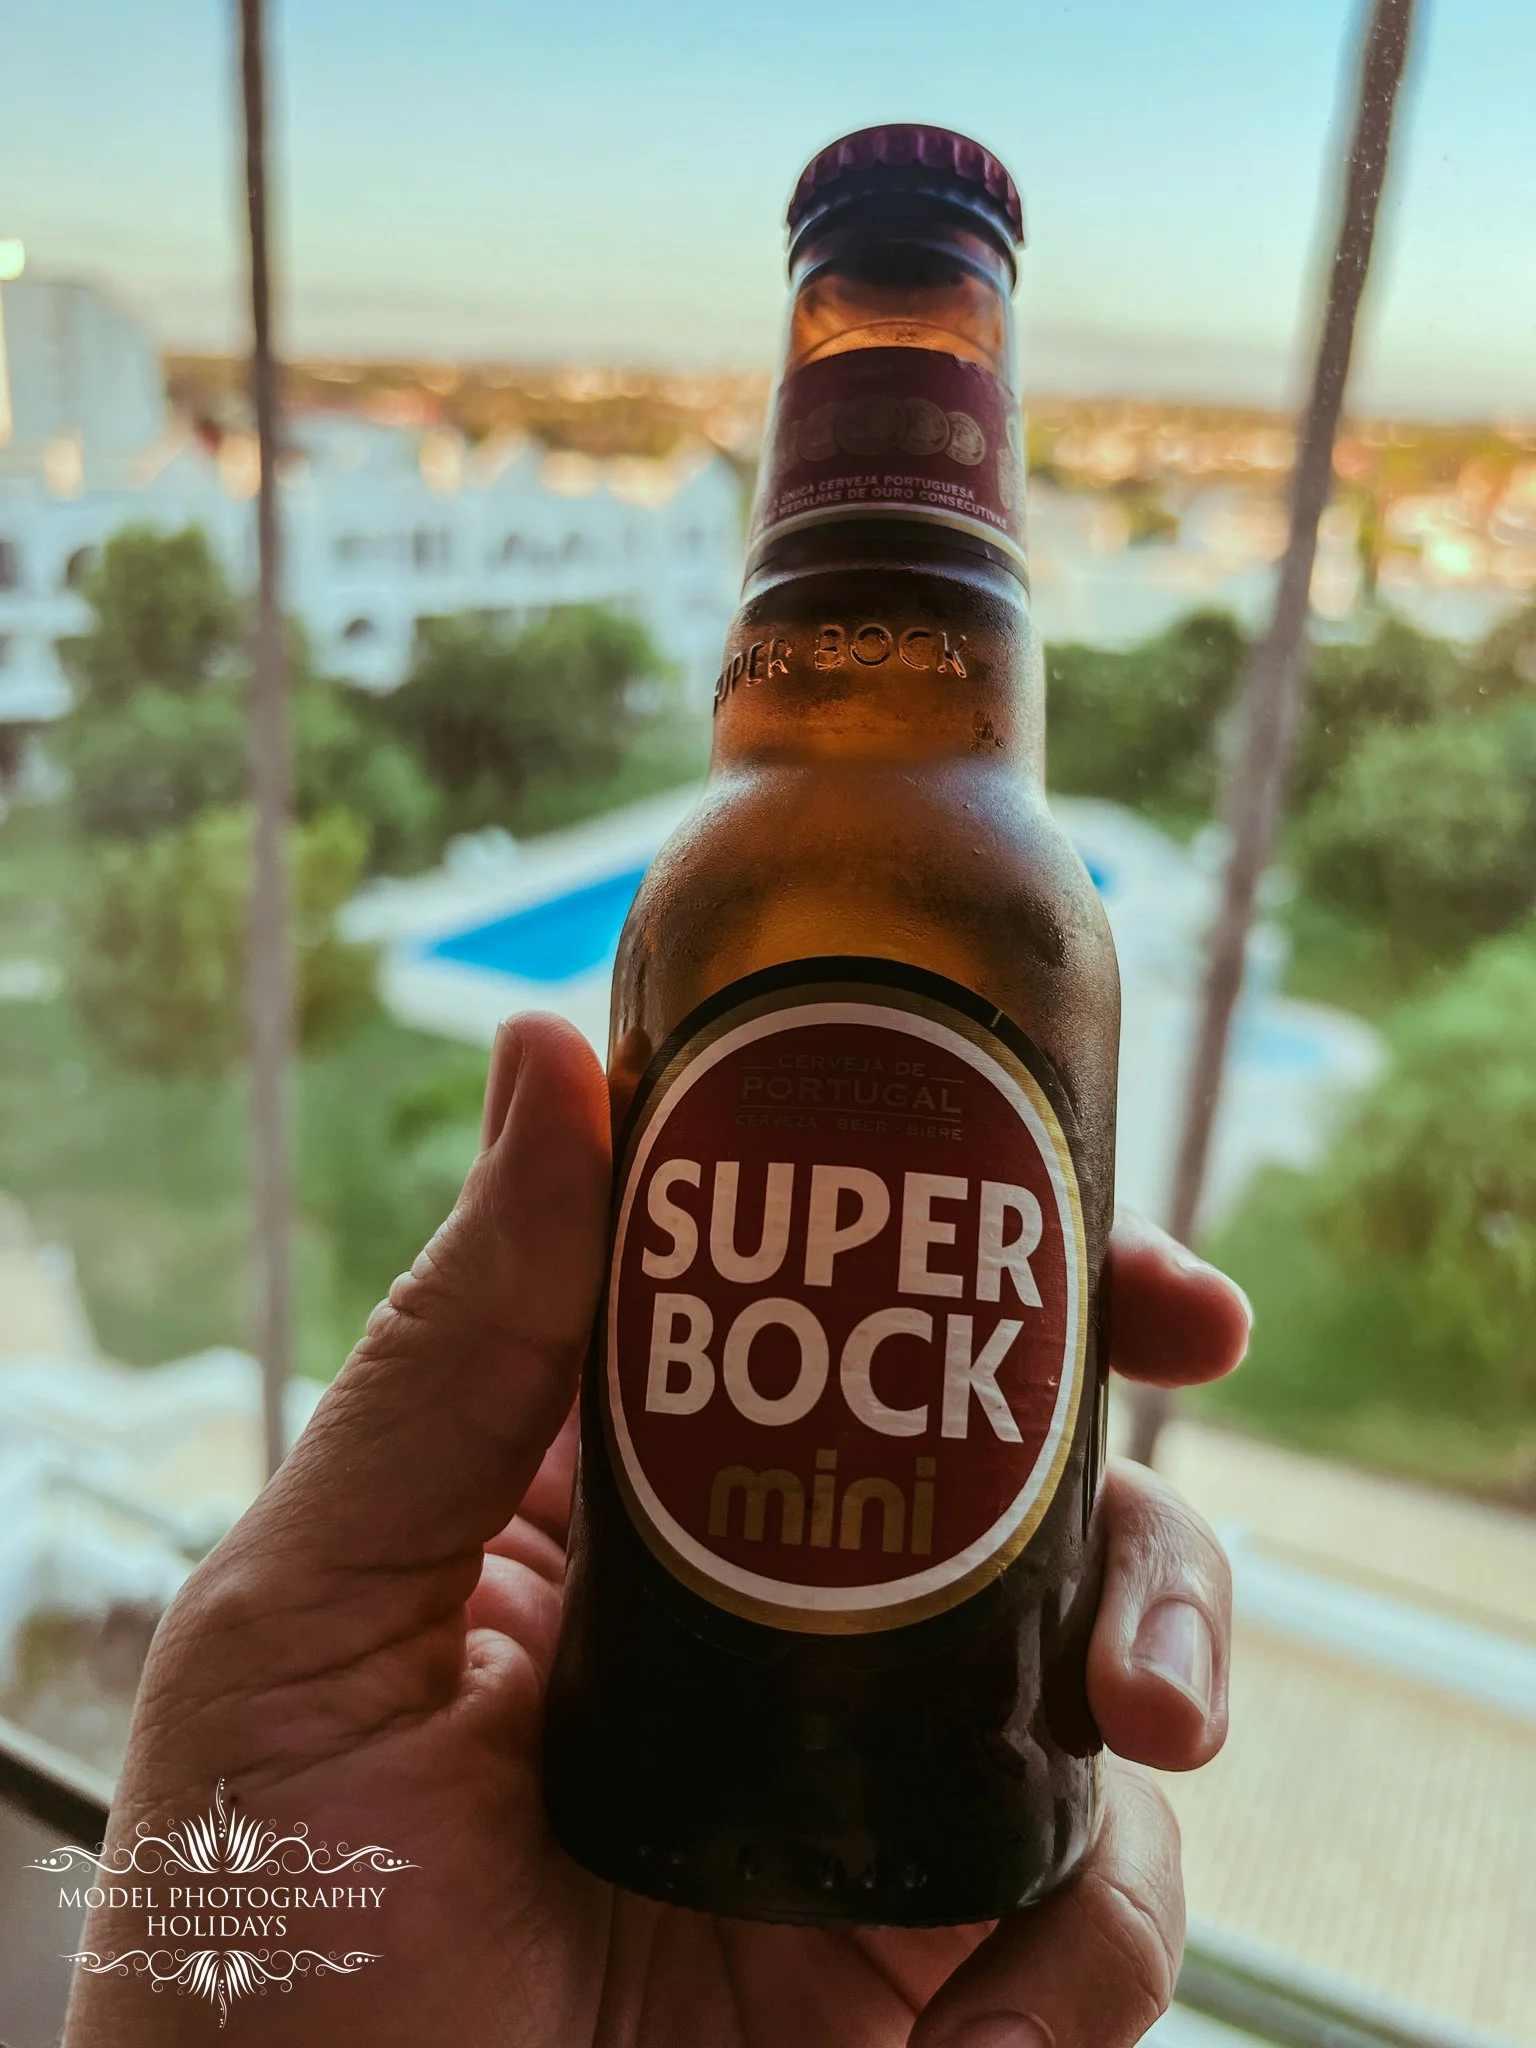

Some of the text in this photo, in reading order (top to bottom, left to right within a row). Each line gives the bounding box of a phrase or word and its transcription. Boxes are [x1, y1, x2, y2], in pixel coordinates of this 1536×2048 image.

[779, 490, 843, 514] MEDALHAS
[848, 488, 867, 499] DE
[871, 487, 914, 500] OURO
[919, 491, 1008, 529] CONSECUTIVAS
[819, 475, 879, 492] CERVEJA
[885, 475, 975, 500] PORTUGUESA
[713, 623, 968, 717] UPER BOCK
[778, 1053, 926, 1078] CERVEJA DE
[741, 1075, 962, 1115] PORTUGAL
[733, 1114, 818, 1129] CERVEZA
[836, 1118, 889, 1134] BEER
[641, 1158, 1044, 1308] SUPER
[645, 1292, 1024, 1444] BOCK
[708, 1449, 937, 1556] mini
